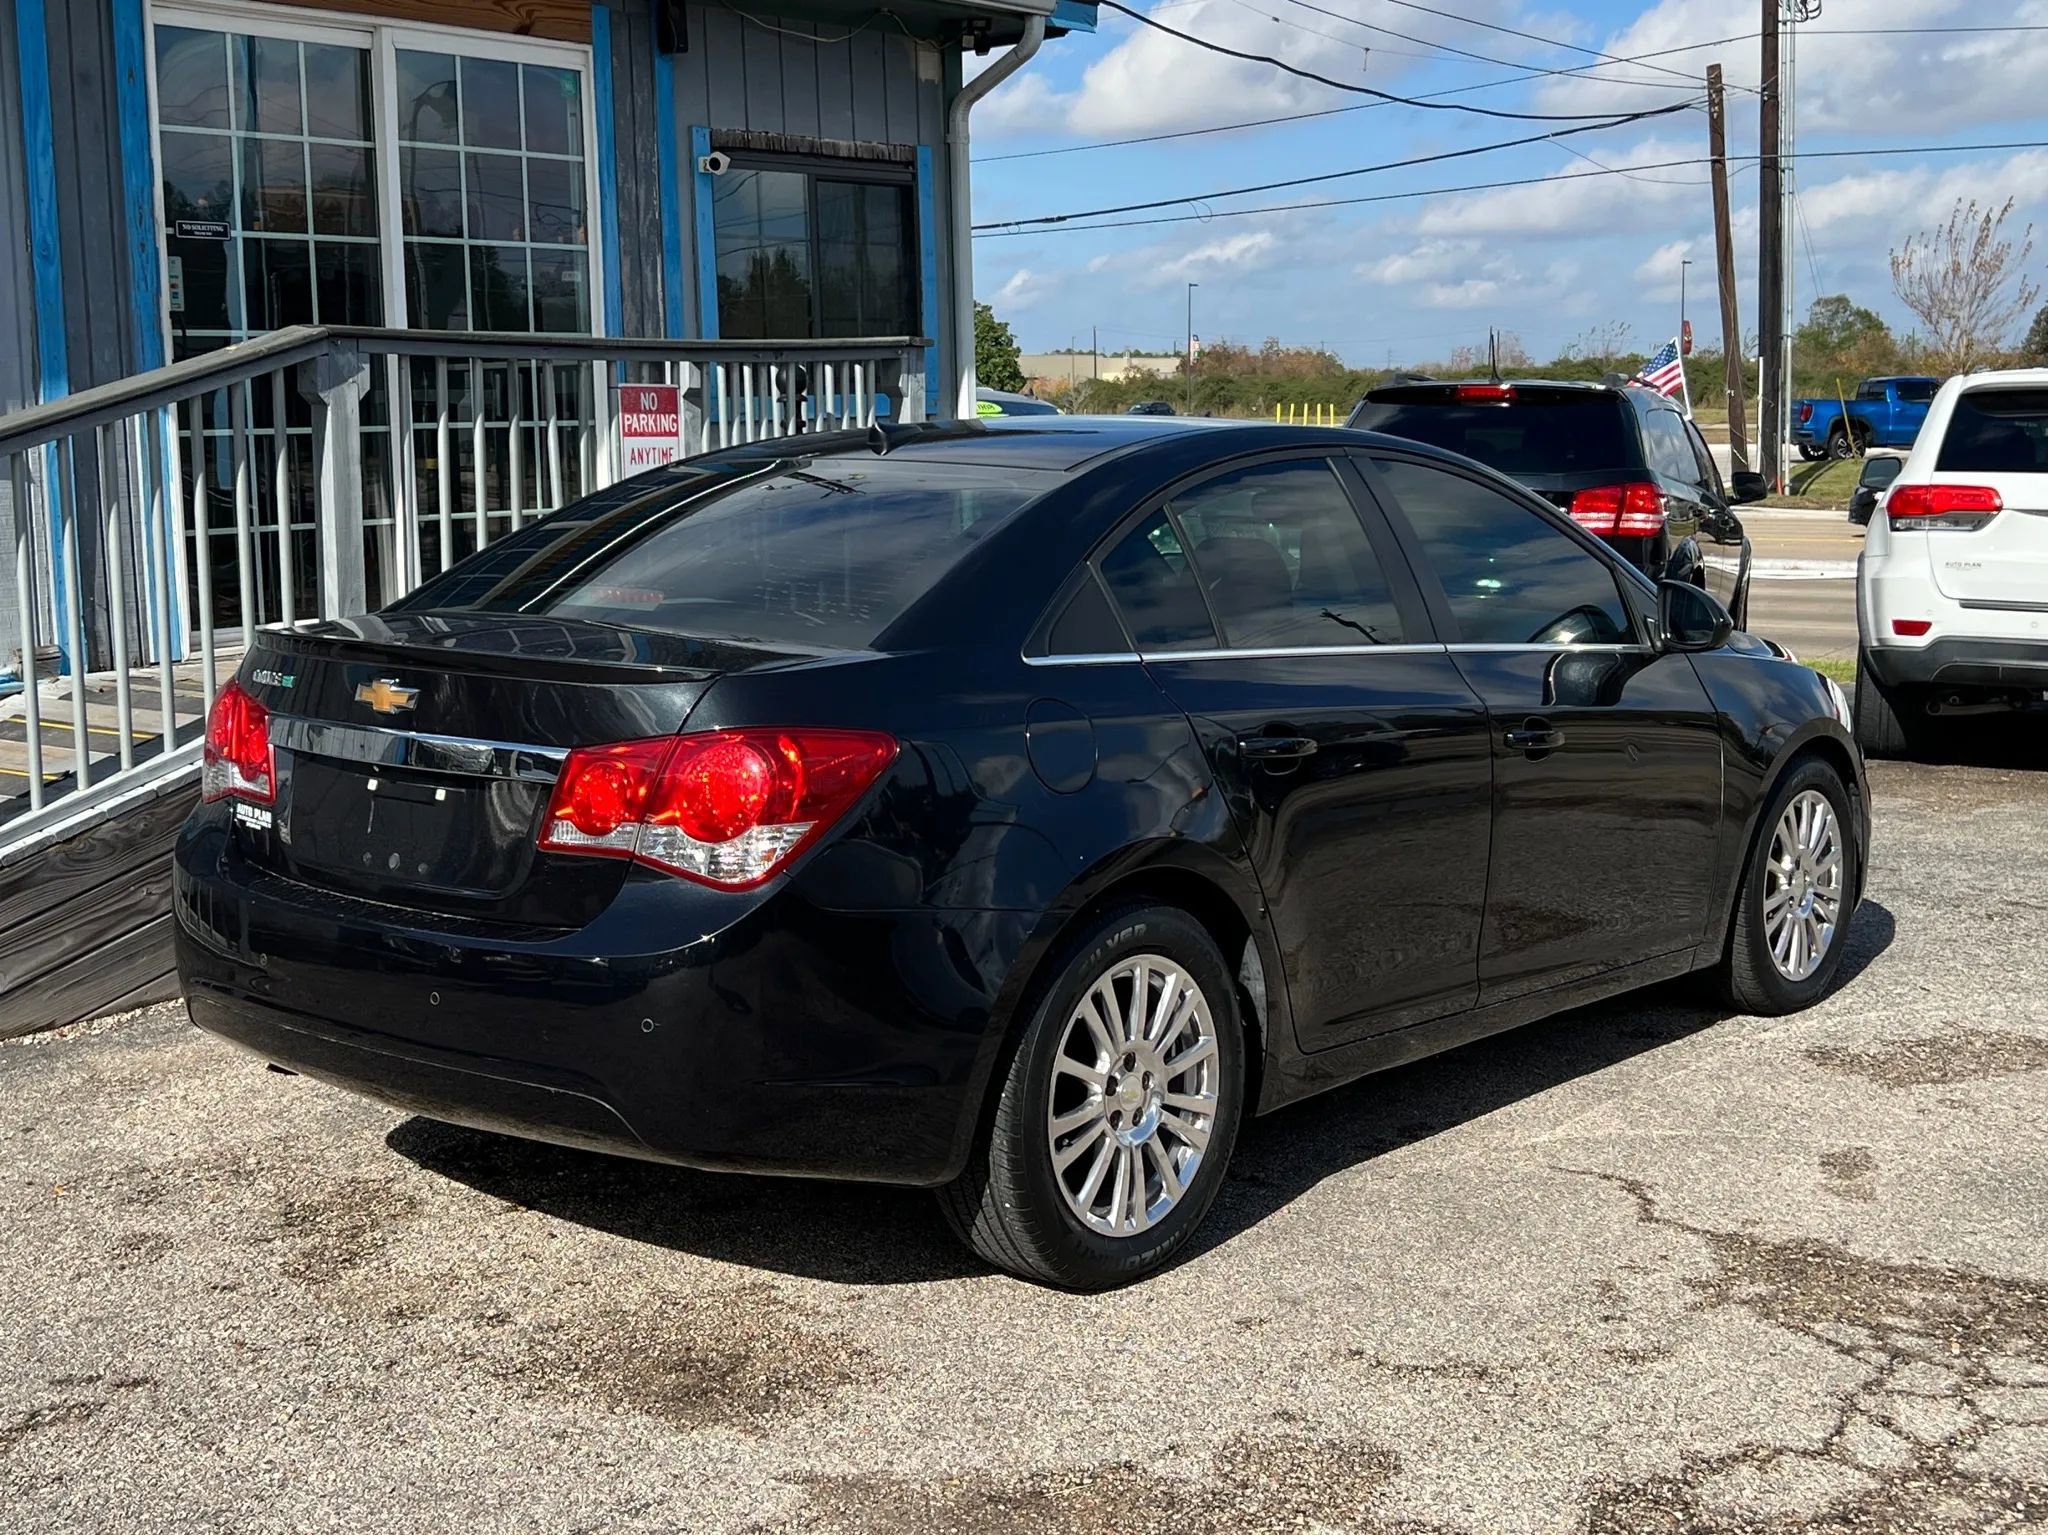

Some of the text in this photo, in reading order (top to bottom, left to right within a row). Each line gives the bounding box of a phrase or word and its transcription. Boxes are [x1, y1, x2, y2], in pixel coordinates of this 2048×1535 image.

[640, 392, 658, 411] NO
[624, 414, 677, 433] PARKING
[630, 447, 674, 465] ANYTIME
